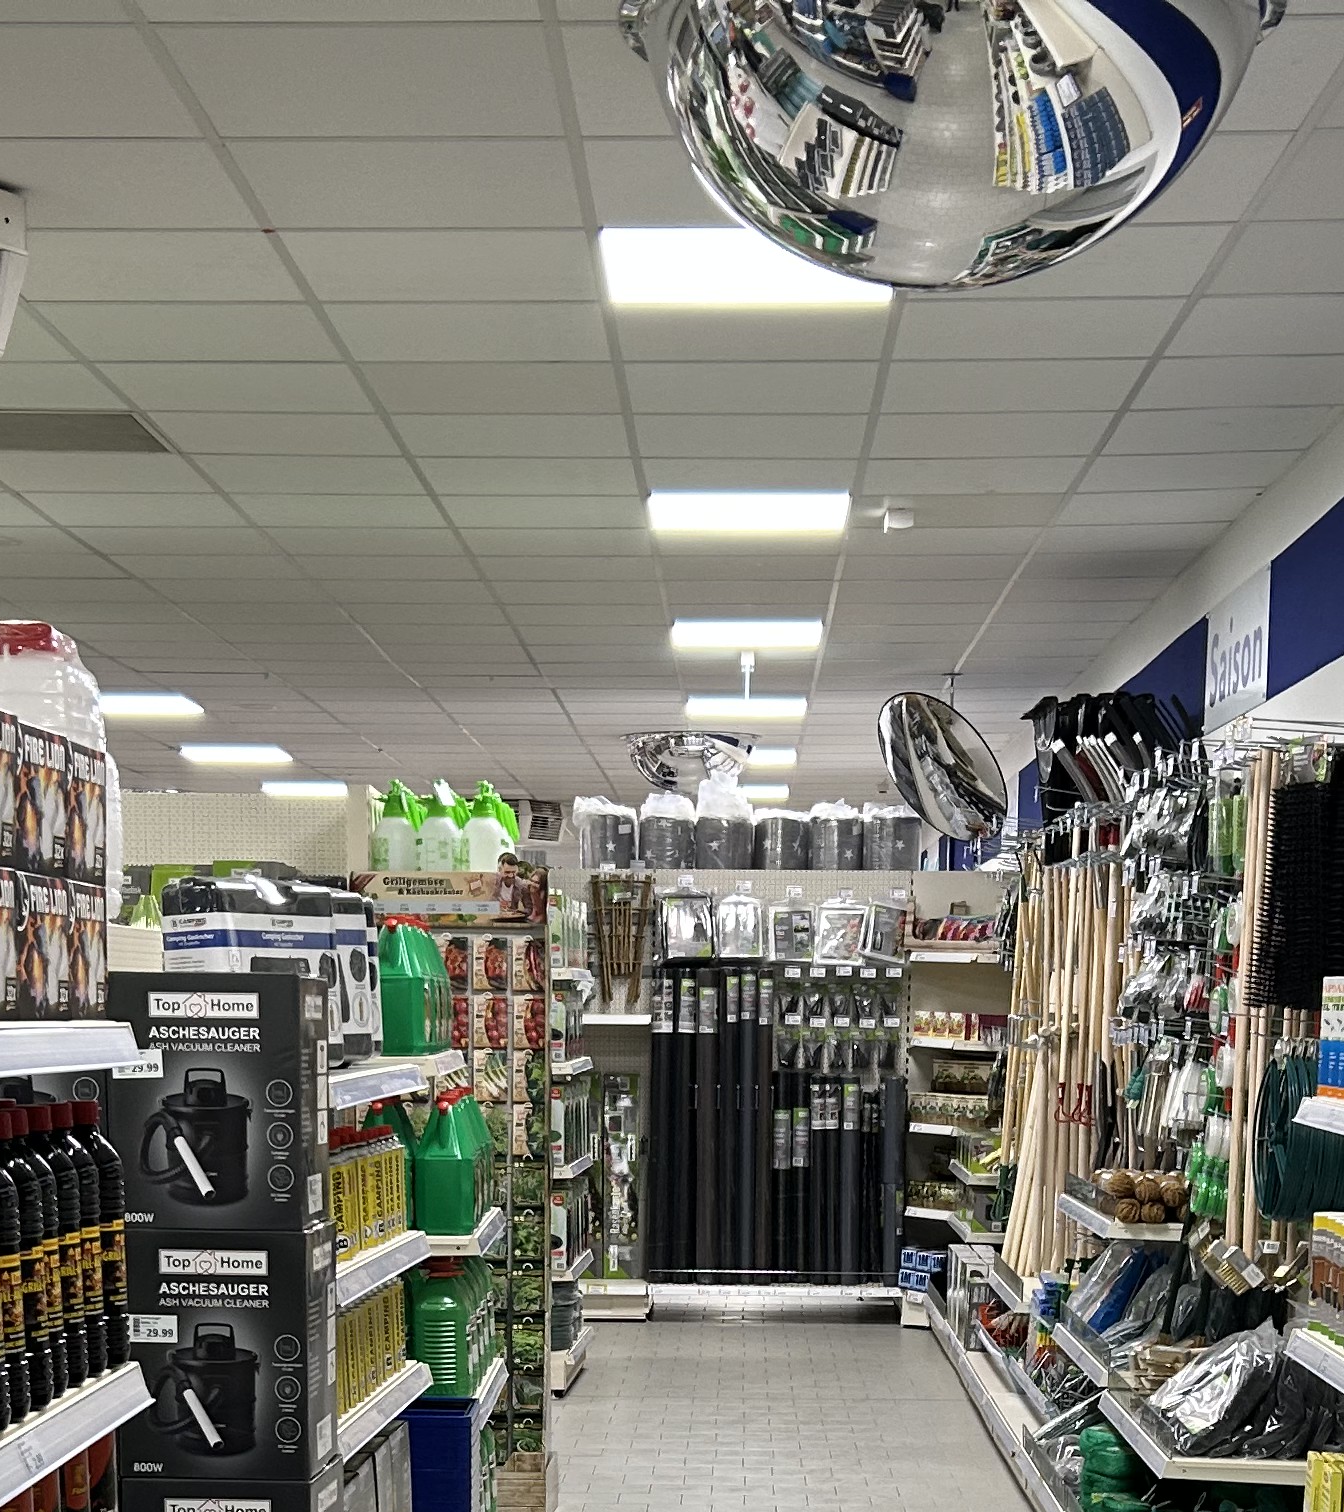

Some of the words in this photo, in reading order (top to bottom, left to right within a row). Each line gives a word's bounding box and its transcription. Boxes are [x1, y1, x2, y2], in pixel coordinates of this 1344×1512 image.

[1210, 616, 1262, 708] Saison
[155, 998, 181, 1013] Top
[211, 998, 254, 1012] Home
[149, 1026, 260, 1040] ASCHESAUGER
[150, 1042, 170, 1051] ASH
[171, 1042, 213, 1052] VACUUM
[215, 1042, 260, 1053] CLEANER
[164, 1256, 191, 1269] Top
[220, 1256, 263, 1269] Home
[159, 1282, 269, 1297] ASCHESAUGER
[159, 1297, 179, 1307] ASH
[181, 1298, 223, 1308] VACUUM
[224, 1298, 269, 1309] CLEANER
[146, 1328, 174, 1338] 29.99
[133, 1463, 163, 1472] 800W
